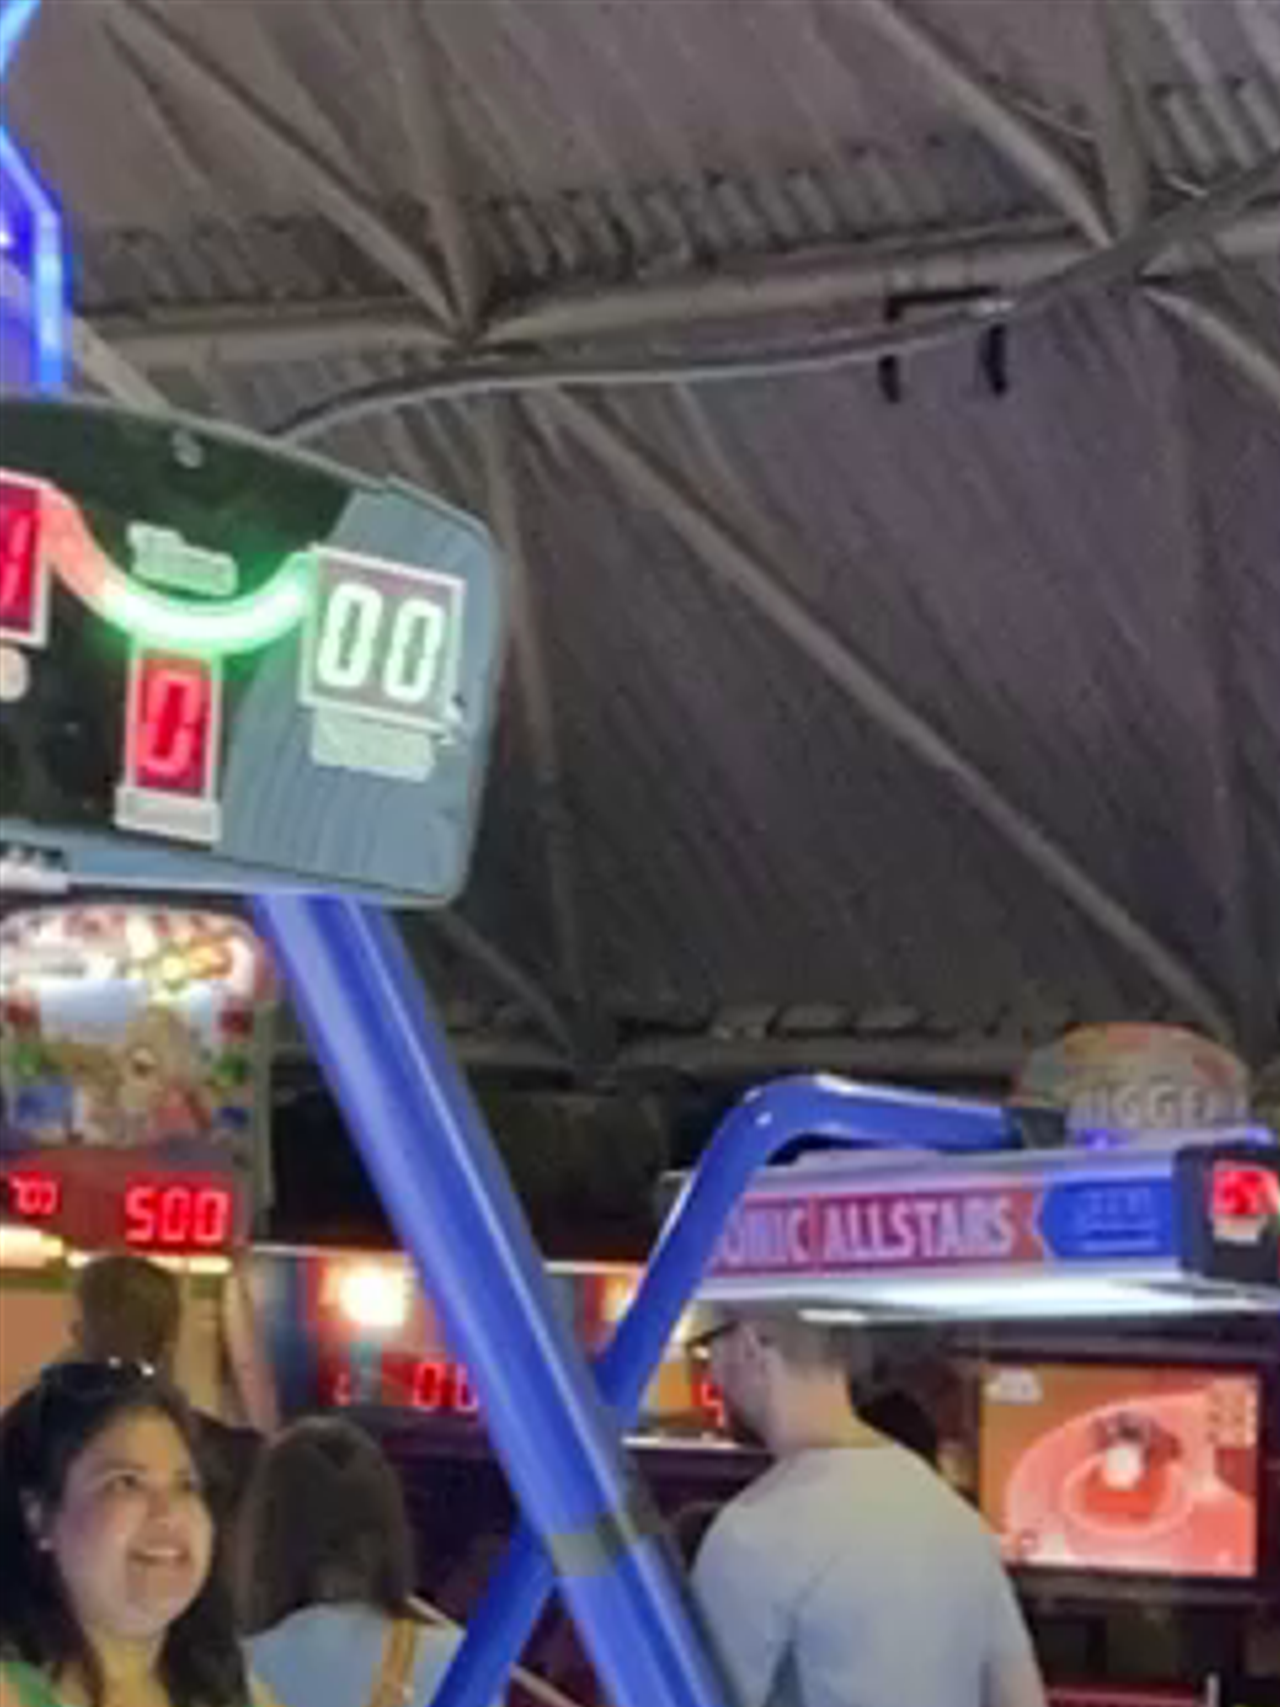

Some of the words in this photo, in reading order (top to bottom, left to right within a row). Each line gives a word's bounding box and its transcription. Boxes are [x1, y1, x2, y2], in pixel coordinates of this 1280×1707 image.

[317, 582, 446, 704] 00
[125, 1186, 231, 1243] 500
[718, 1206, 810, 1265] ONIC
[823, 1197, 1014, 1261] ALLSTARS
